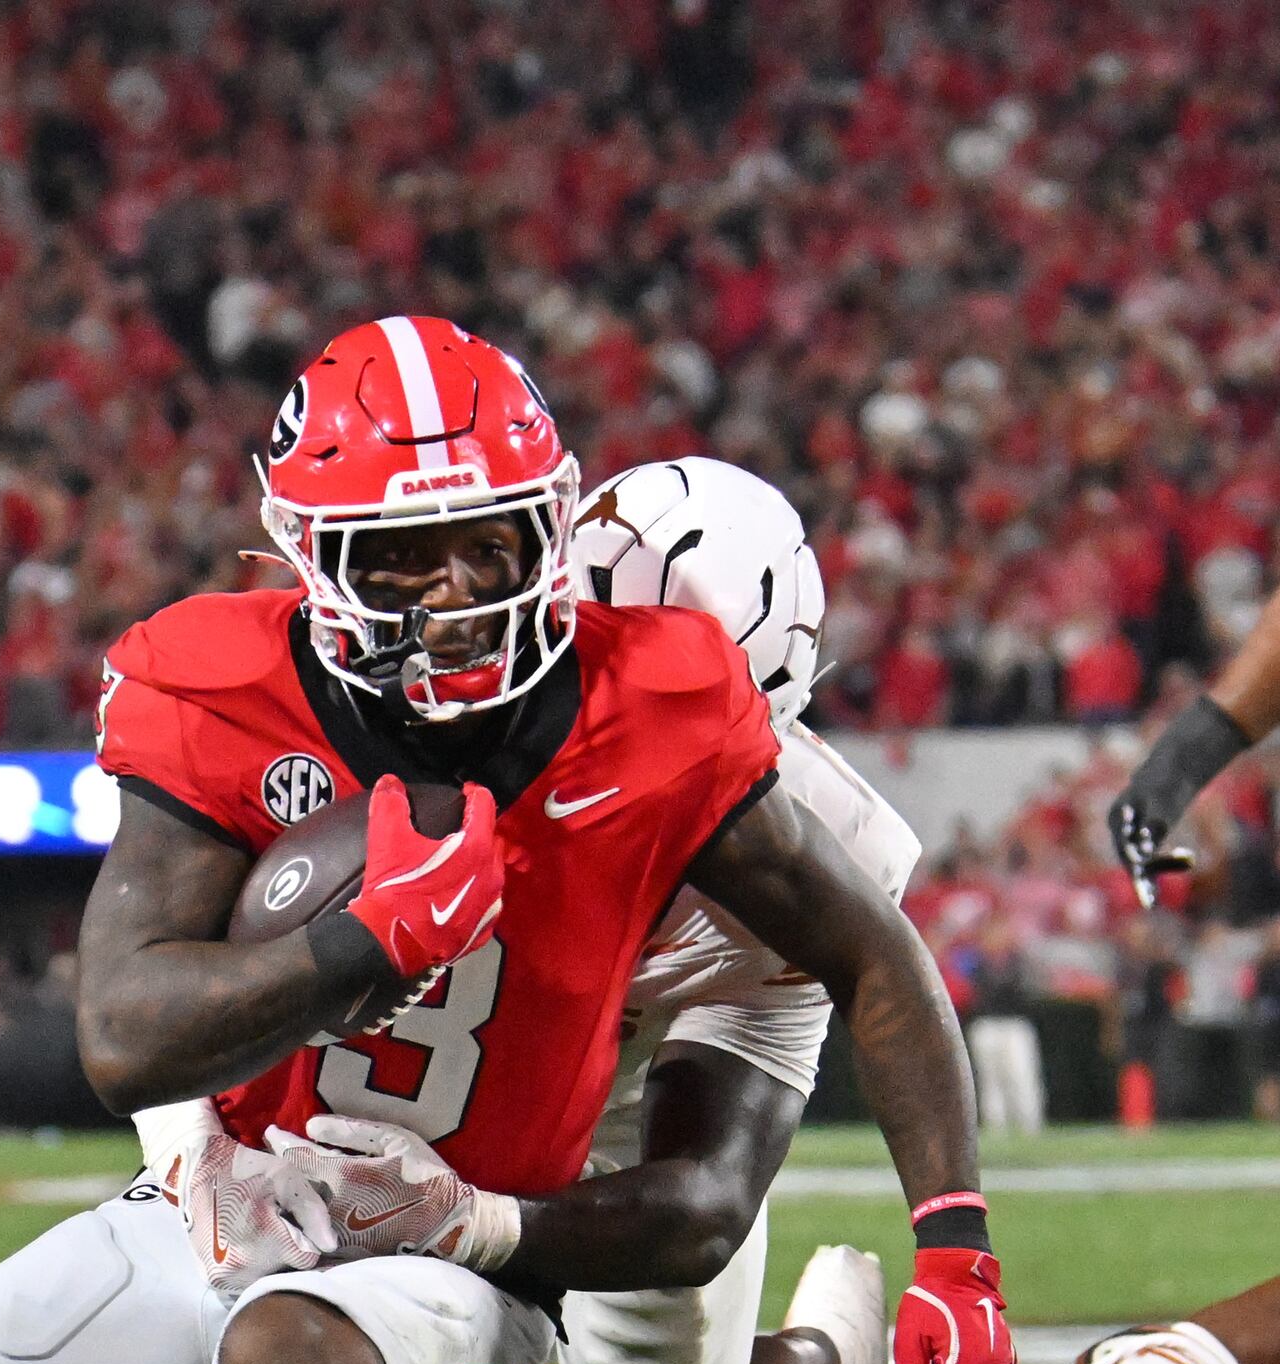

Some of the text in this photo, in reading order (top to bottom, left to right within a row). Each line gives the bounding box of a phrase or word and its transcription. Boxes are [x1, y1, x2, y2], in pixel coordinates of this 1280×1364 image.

[401, 471, 475, 497] DAWGS
[262, 753, 335, 827] SEC
[305, 928, 506, 1146] 3
